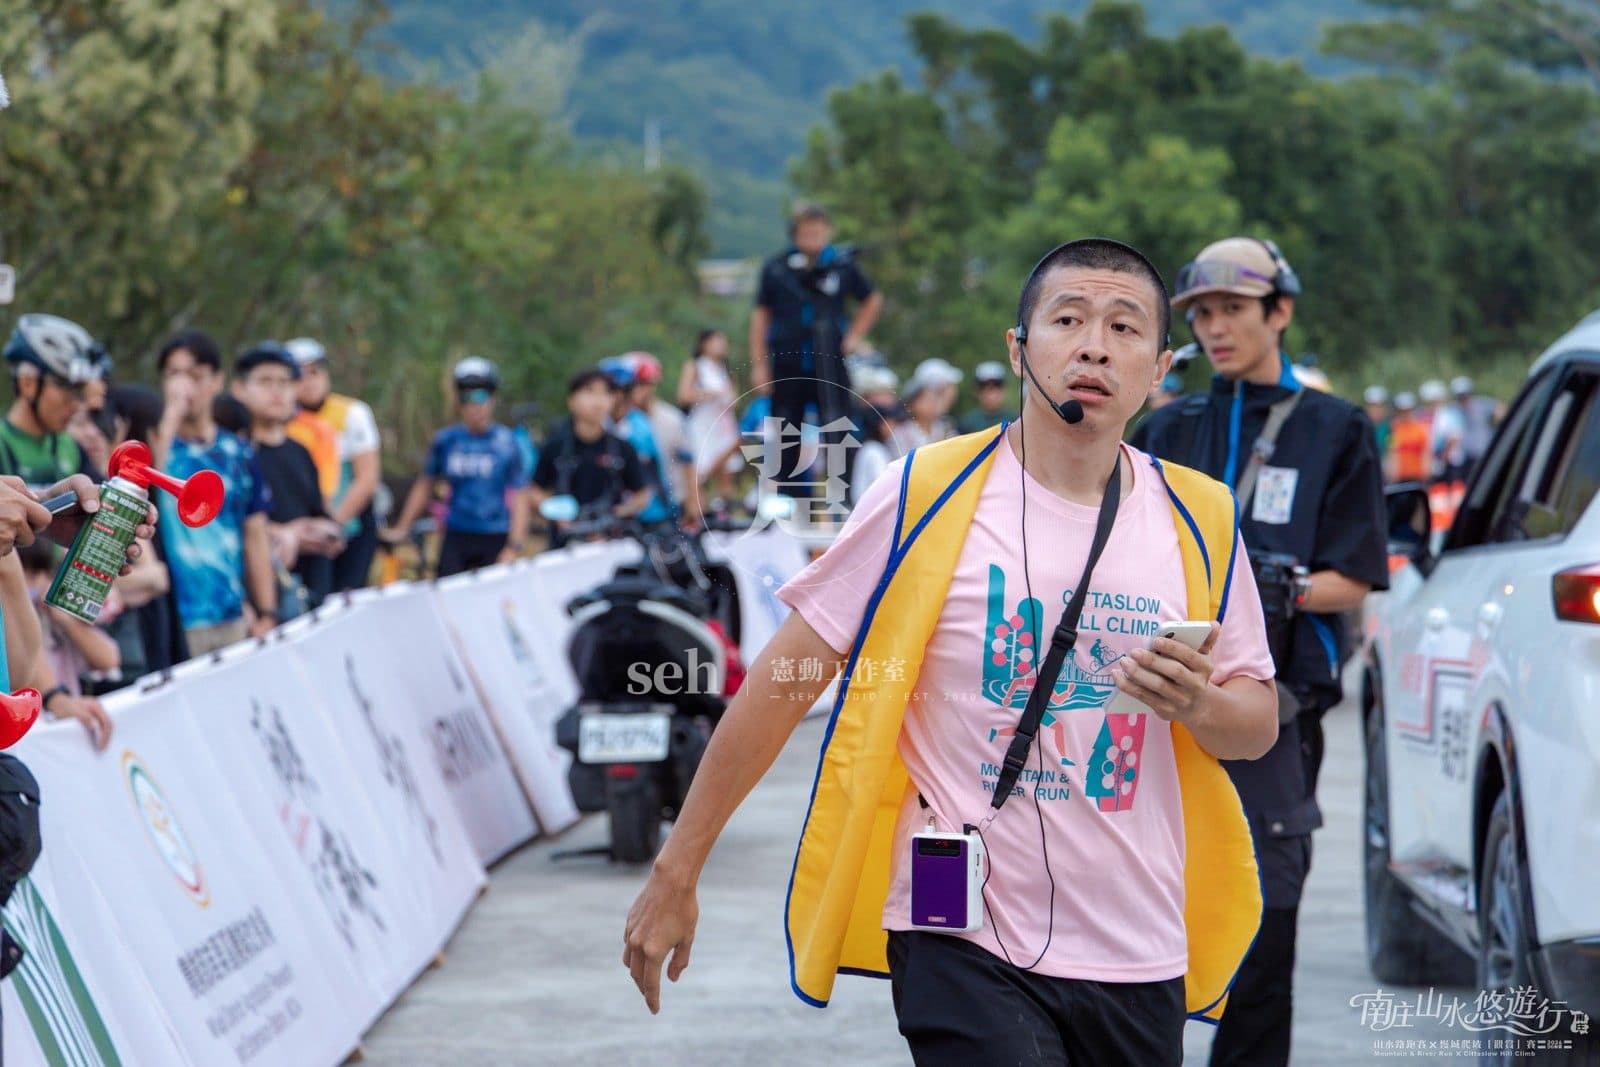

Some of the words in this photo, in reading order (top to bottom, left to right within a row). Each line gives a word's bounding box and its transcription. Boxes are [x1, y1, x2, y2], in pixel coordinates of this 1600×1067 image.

[1062, 589, 1160, 614] CTASLOW
[980, 763, 1055, 783] MOTAIN
[1059, 774, 1070, 785] &
[982, 780, 1025, 797] RIR
[1037, 788, 1070, 801] RUN
